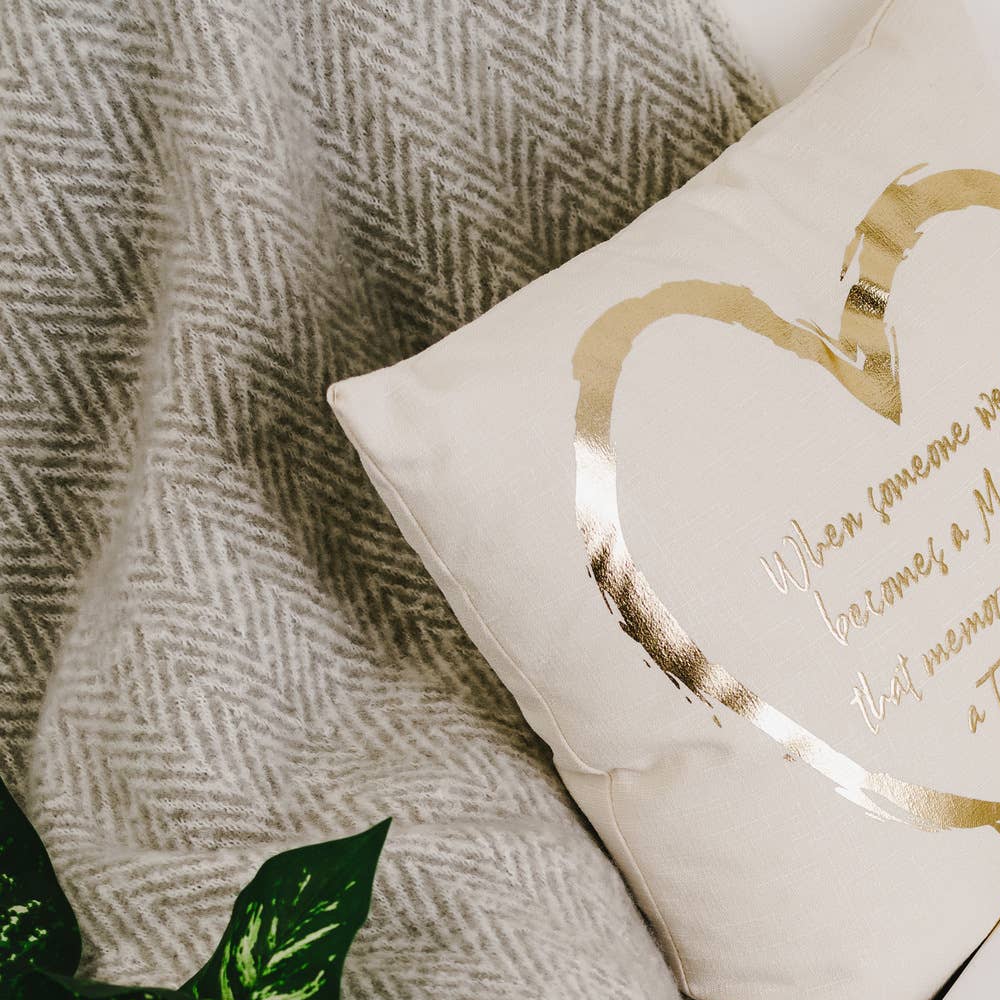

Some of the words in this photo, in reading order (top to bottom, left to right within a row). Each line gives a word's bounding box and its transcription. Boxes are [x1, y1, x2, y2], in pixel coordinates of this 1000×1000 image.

[760, 512, 863, 594] When
[867, 421, 970, 524] someone
[814, 536, 948, 646] becomes
[951, 522, 969, 551] a
[851, 653, 923, 735] that
[968, 705, 986, 733] a
